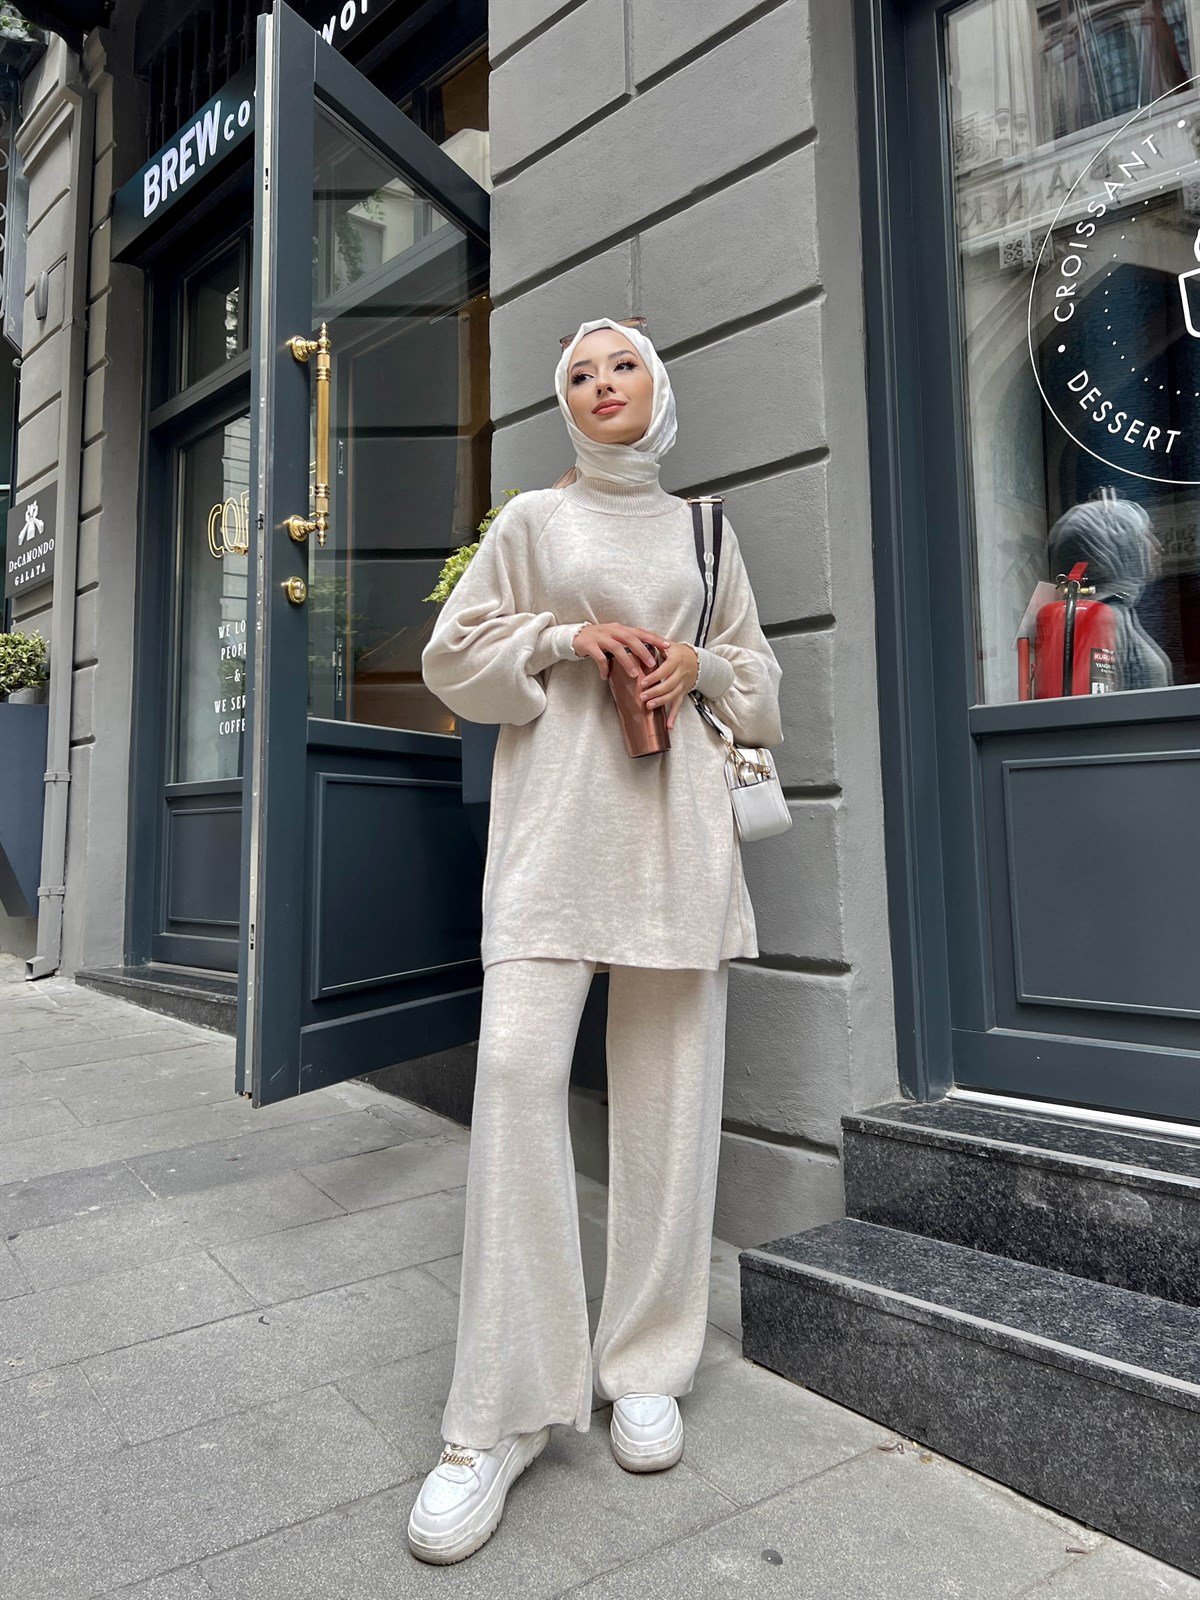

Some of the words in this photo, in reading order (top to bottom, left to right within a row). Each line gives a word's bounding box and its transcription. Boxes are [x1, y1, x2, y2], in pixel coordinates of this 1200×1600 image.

[143, 100, 221, 218] BREW
[223, 90, 256, 141] CO
[1053, 134, 1160, 323] CROISSANT
[1067, 369, 1182, 454] DESSERT
[14, 562, 46, 586] GALATA
[218, 624, 231, 639] WE
[214, 699, 227, 714] WE
